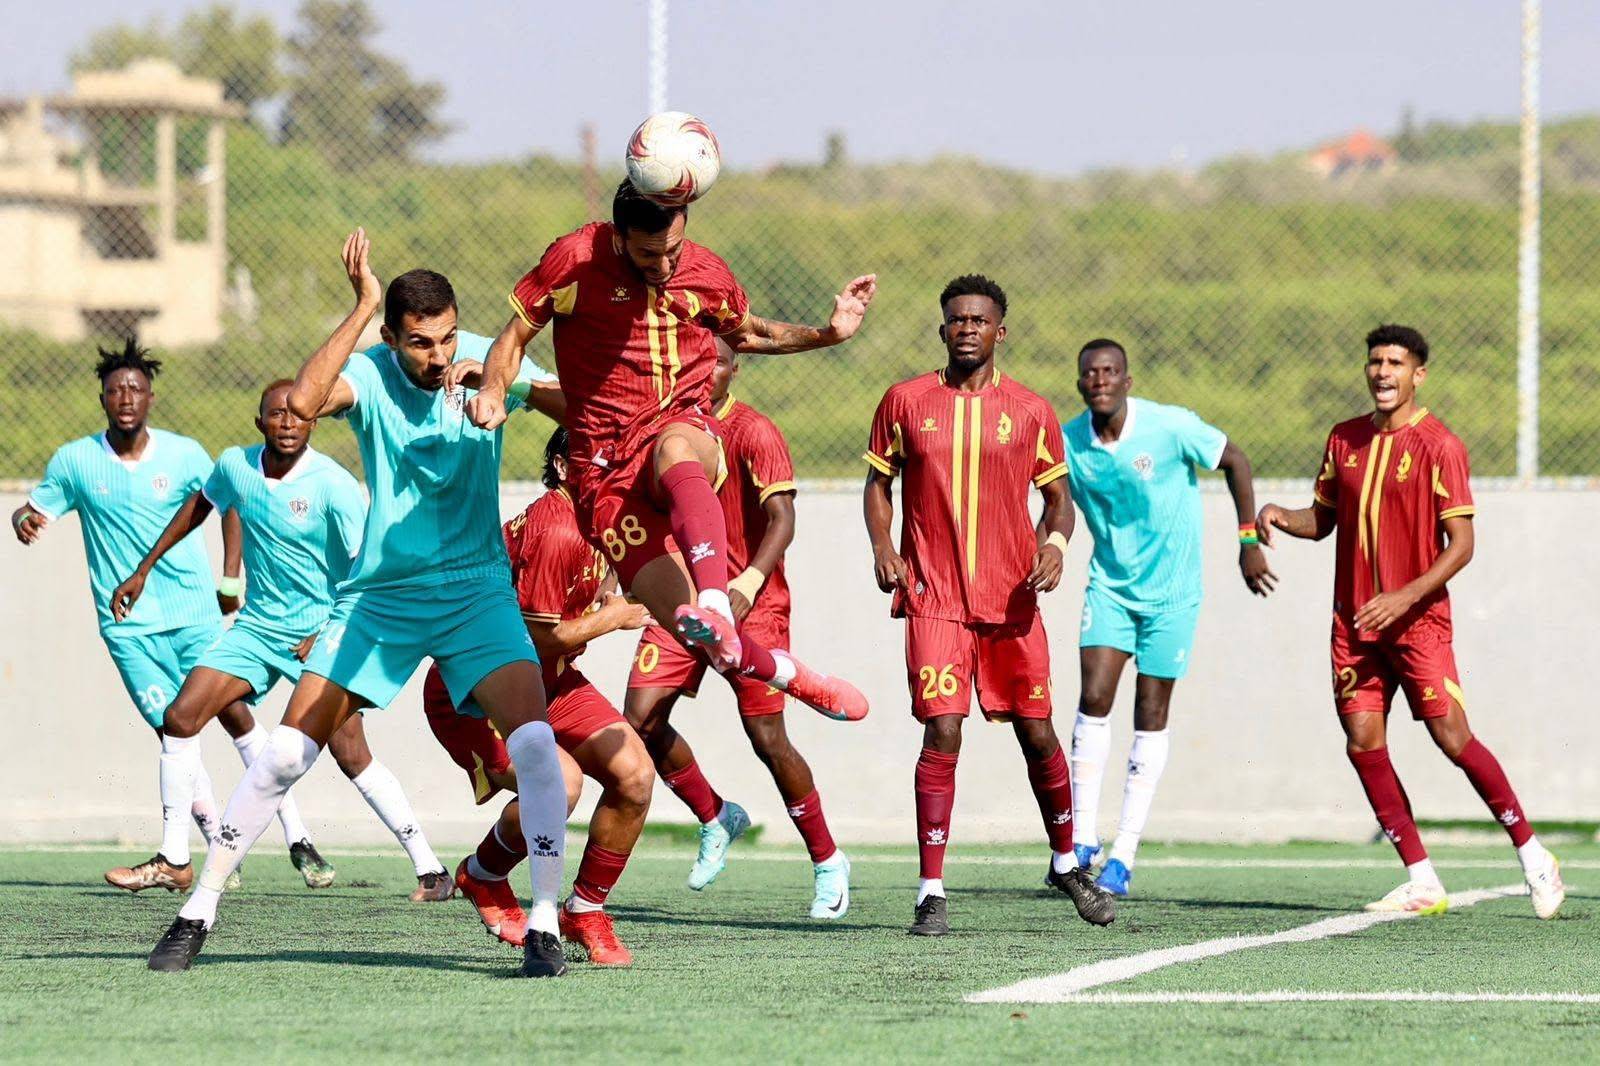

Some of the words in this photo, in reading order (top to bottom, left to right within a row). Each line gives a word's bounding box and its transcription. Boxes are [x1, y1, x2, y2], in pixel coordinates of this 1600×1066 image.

[603, 515, 647, 562] 88
[635, 643, 660, 673] 0
[919, 663, 958, 700] 26
[1333, 667, 1358, 699] 2
[213, 836, 237, 851] KELME
[533, 849, 559, 858] KELME
